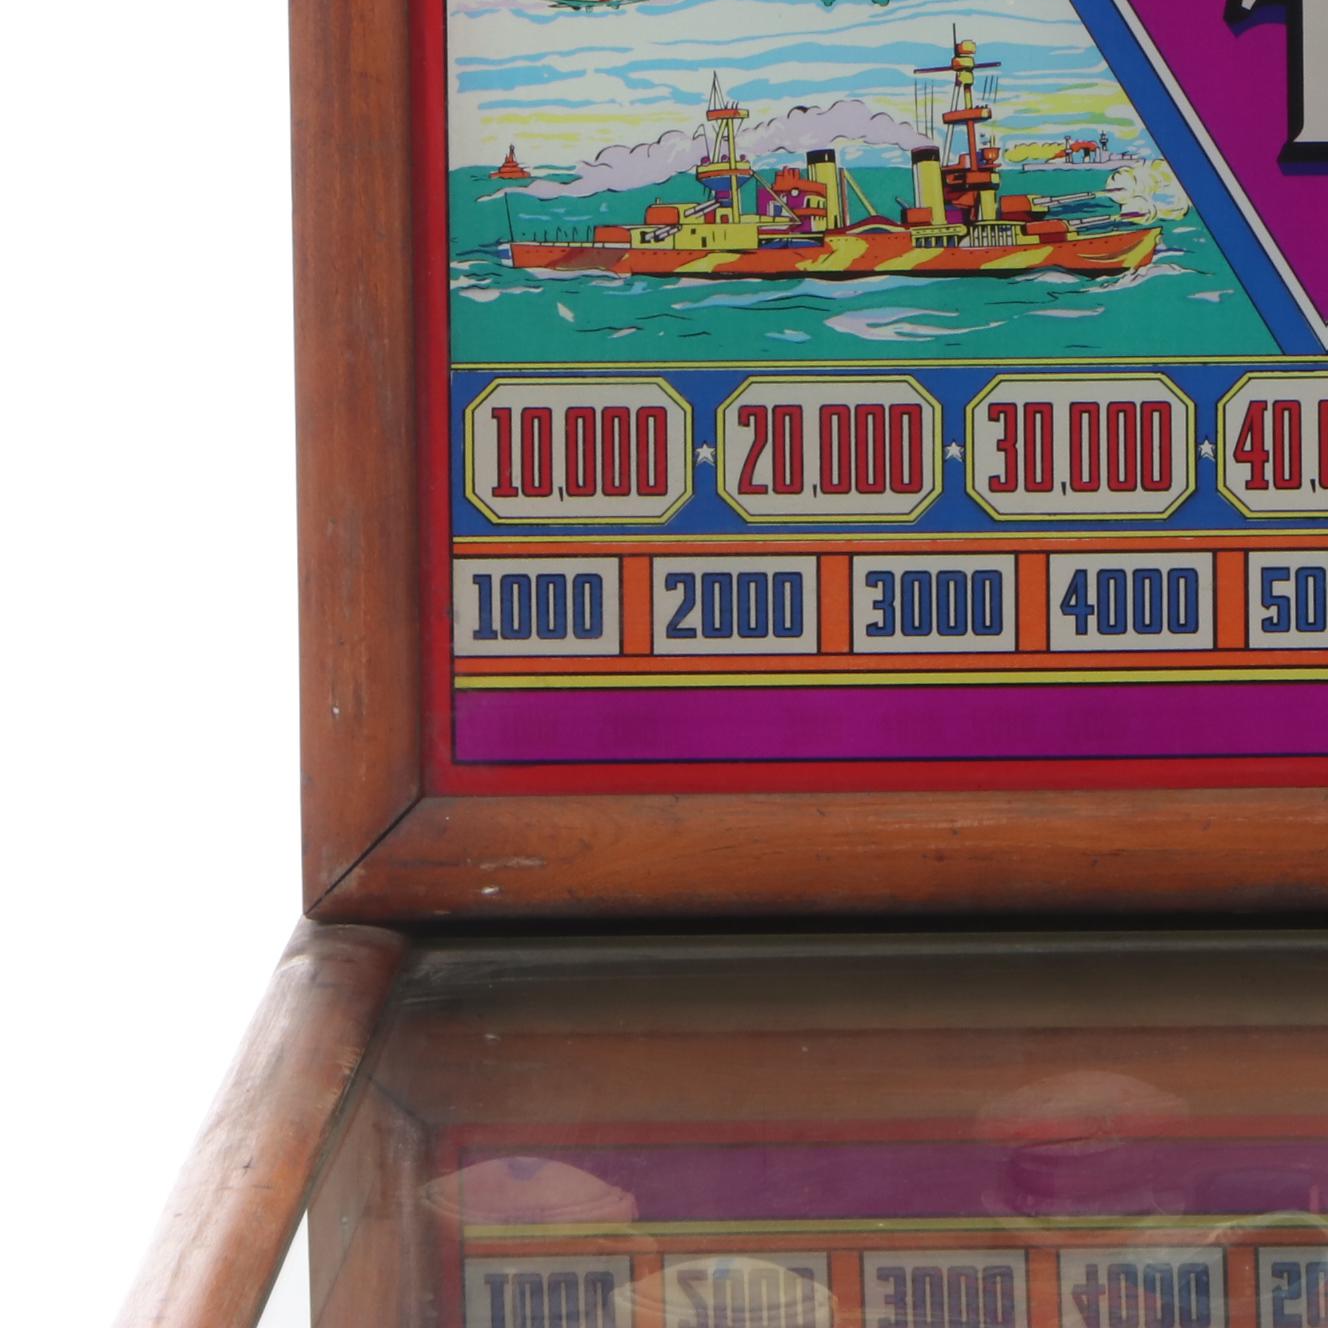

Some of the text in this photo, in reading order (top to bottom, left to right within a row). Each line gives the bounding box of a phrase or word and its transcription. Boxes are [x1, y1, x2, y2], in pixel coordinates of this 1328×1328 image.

[491, 406, 668, 501] 10,000
[738, 404, 923, 497] 20,000
[988, 401, 1172, 495] 30,000
[472, 573, 603, 640] 1000
[665, 572, 804, 639] 2000
[865, 570, 1003, 637] 3000
[1060, 568, 1199, 635] 4000
